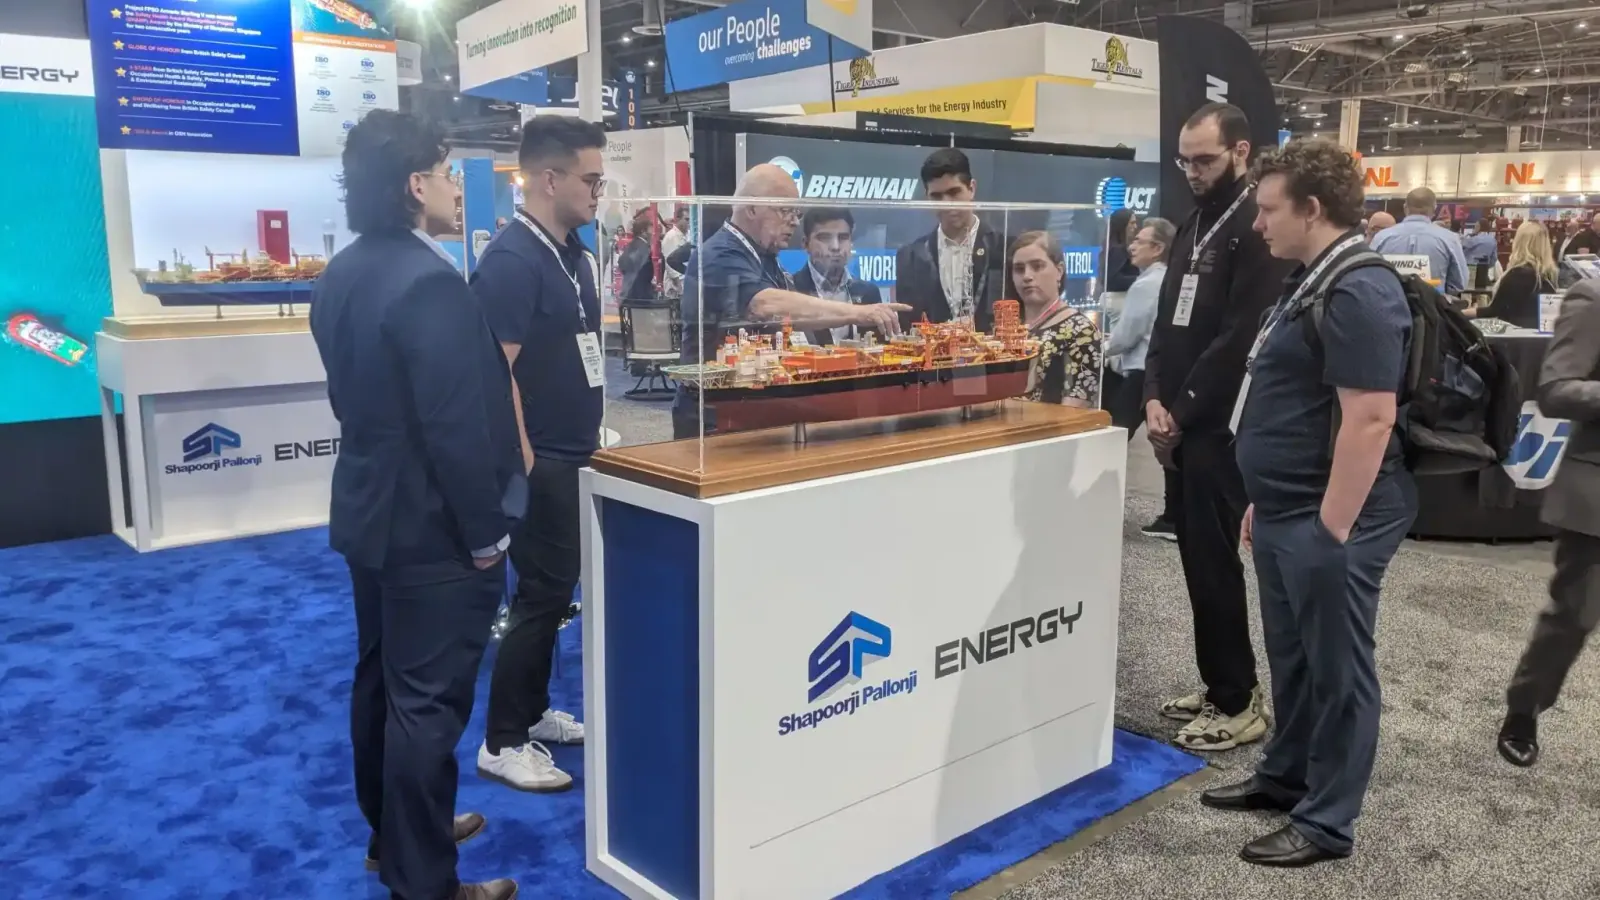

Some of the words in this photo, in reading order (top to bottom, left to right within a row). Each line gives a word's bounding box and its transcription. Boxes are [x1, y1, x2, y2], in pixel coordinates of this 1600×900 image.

[466, 39, 486, 60] Turning
[486, 28, 519, 51] innovation
[519, 22, 533, 38] into
[534, 3, 577, 33] recognition
[698, 27, 723, 53] our
[727, 7, 780, 48] People
[725, 51, 754, 65] overcoming
[757, 34, 811, 60] challenges
[883, 106, 915, 116] Services
[916, 104, 927, 113] for
[930, 103, 941, 112] the
[943, 101, 970, 113] Energy
[972, 98, 1007, 110] Industry
[608, 140, 632, 154] People
[1364, 166, 1400, 187] NL
[1505, 162, 1543, 185] NL
[805, 175, 918, 200] BRENNAN
[1124, 187, 1156, 209] UCT
[165, 459, 220, 474] Shapoorji
[222, 454, 262, 467] Pallonji
[935, 600, 1083, 680] ENERGY
[778, 690, 860, 736] Shapoorji
[863, 670, 918, 705] Pallonji
